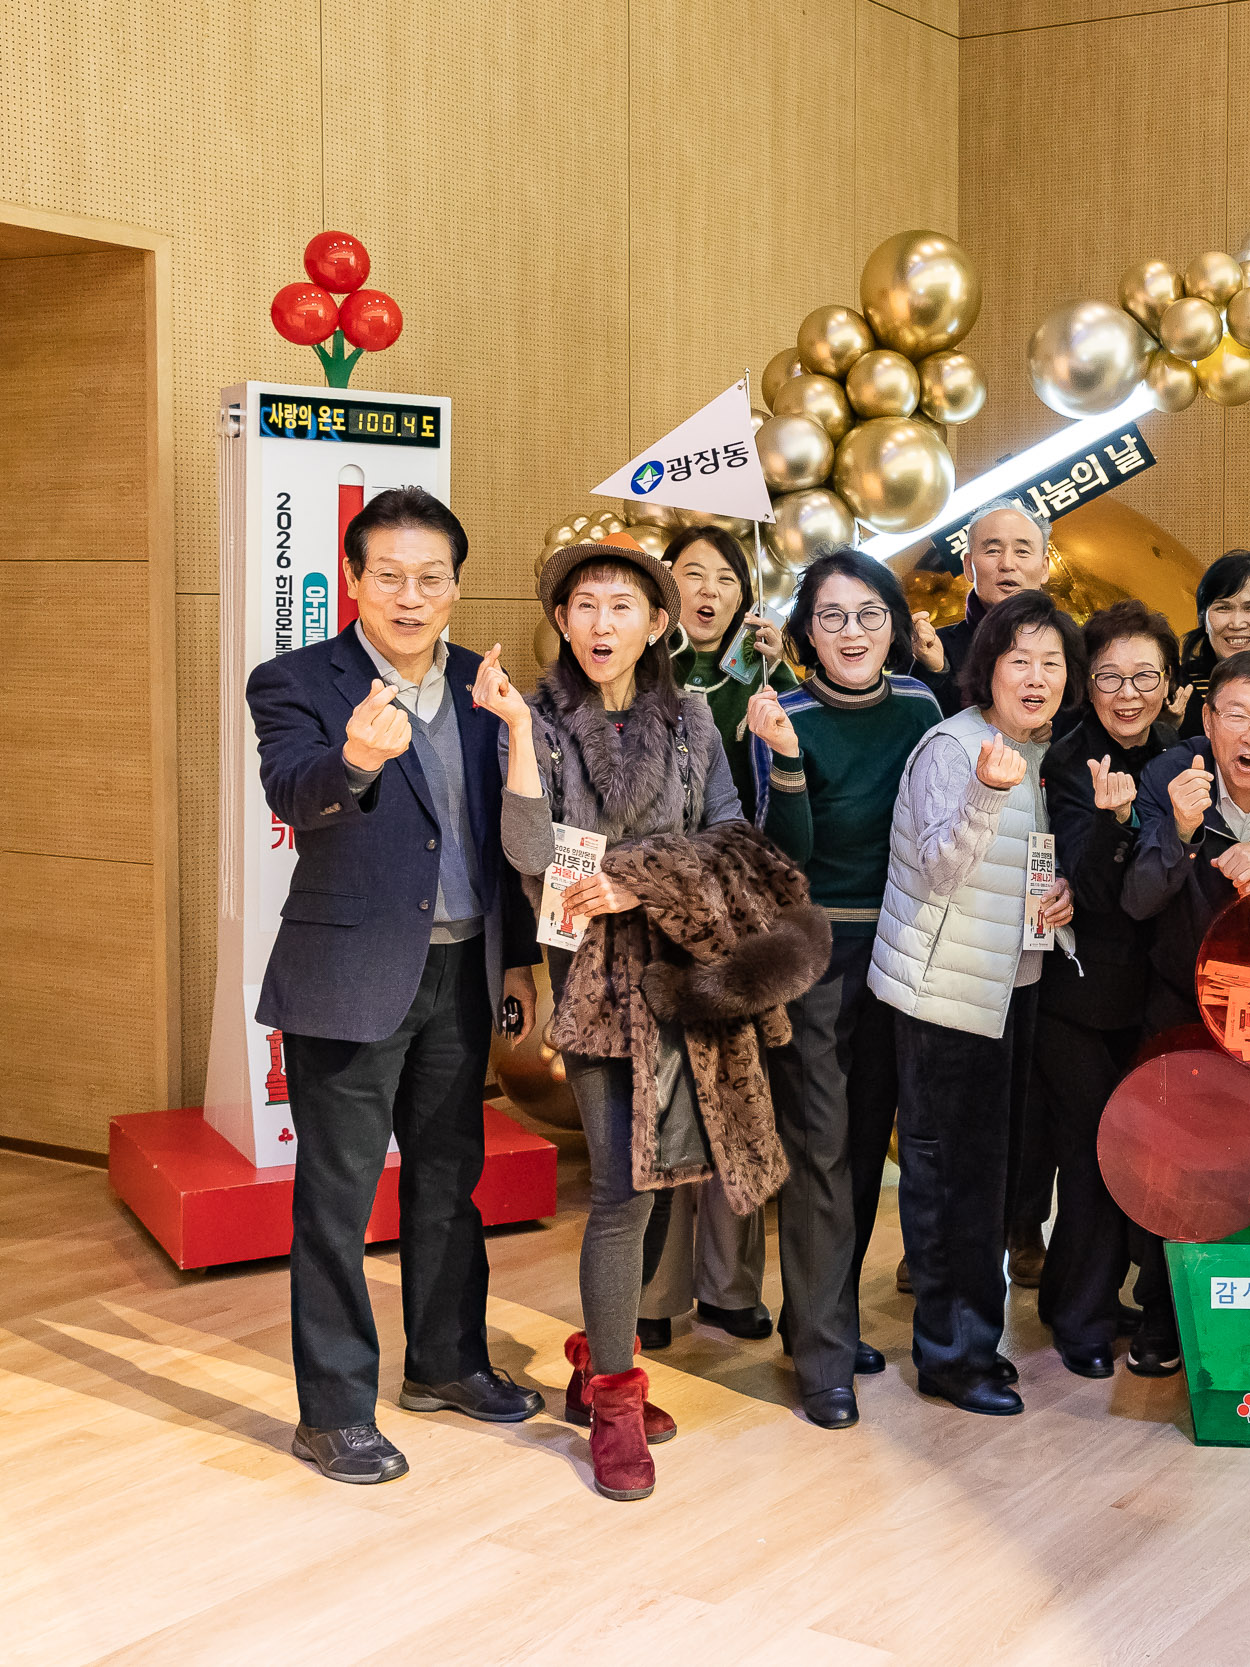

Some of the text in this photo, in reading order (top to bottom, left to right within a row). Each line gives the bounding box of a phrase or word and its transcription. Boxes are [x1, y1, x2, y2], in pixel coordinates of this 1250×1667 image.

[268, 402, 435, 438] 사랑의 온도 100.4 도
[666, 440, 749, 482] 광장동
[1012, 433, 1146, 518] 나눔의 날
[276, 492, 292, 568] 2026
[553, 852, 596, 875] 따뜻한
[1031, 859, 1053, 873] 따뜻한
